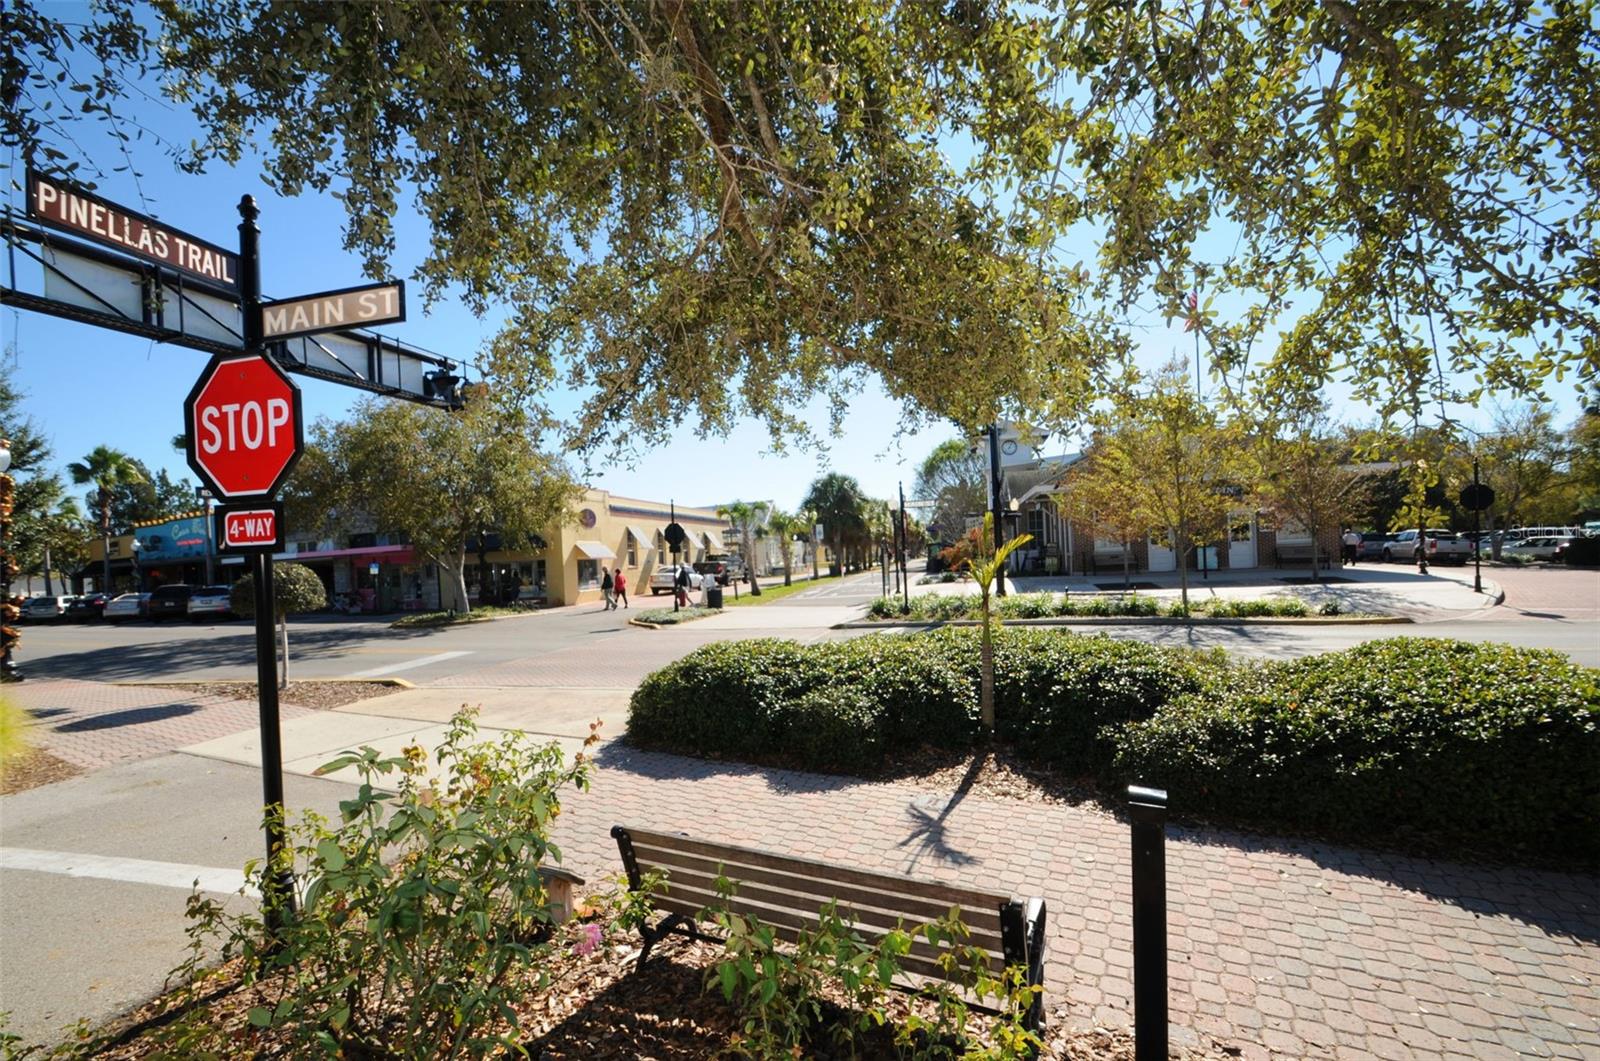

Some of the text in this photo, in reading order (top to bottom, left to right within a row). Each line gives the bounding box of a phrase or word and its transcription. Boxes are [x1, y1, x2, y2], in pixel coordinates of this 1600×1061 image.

[38, 181, 234, 284] PINELLAS TRAIL
[264, 289, 397, 334] MAIN ST
[202, 398, 289, 454] STOP
[229, 518, 272, 538] 4-WAY
